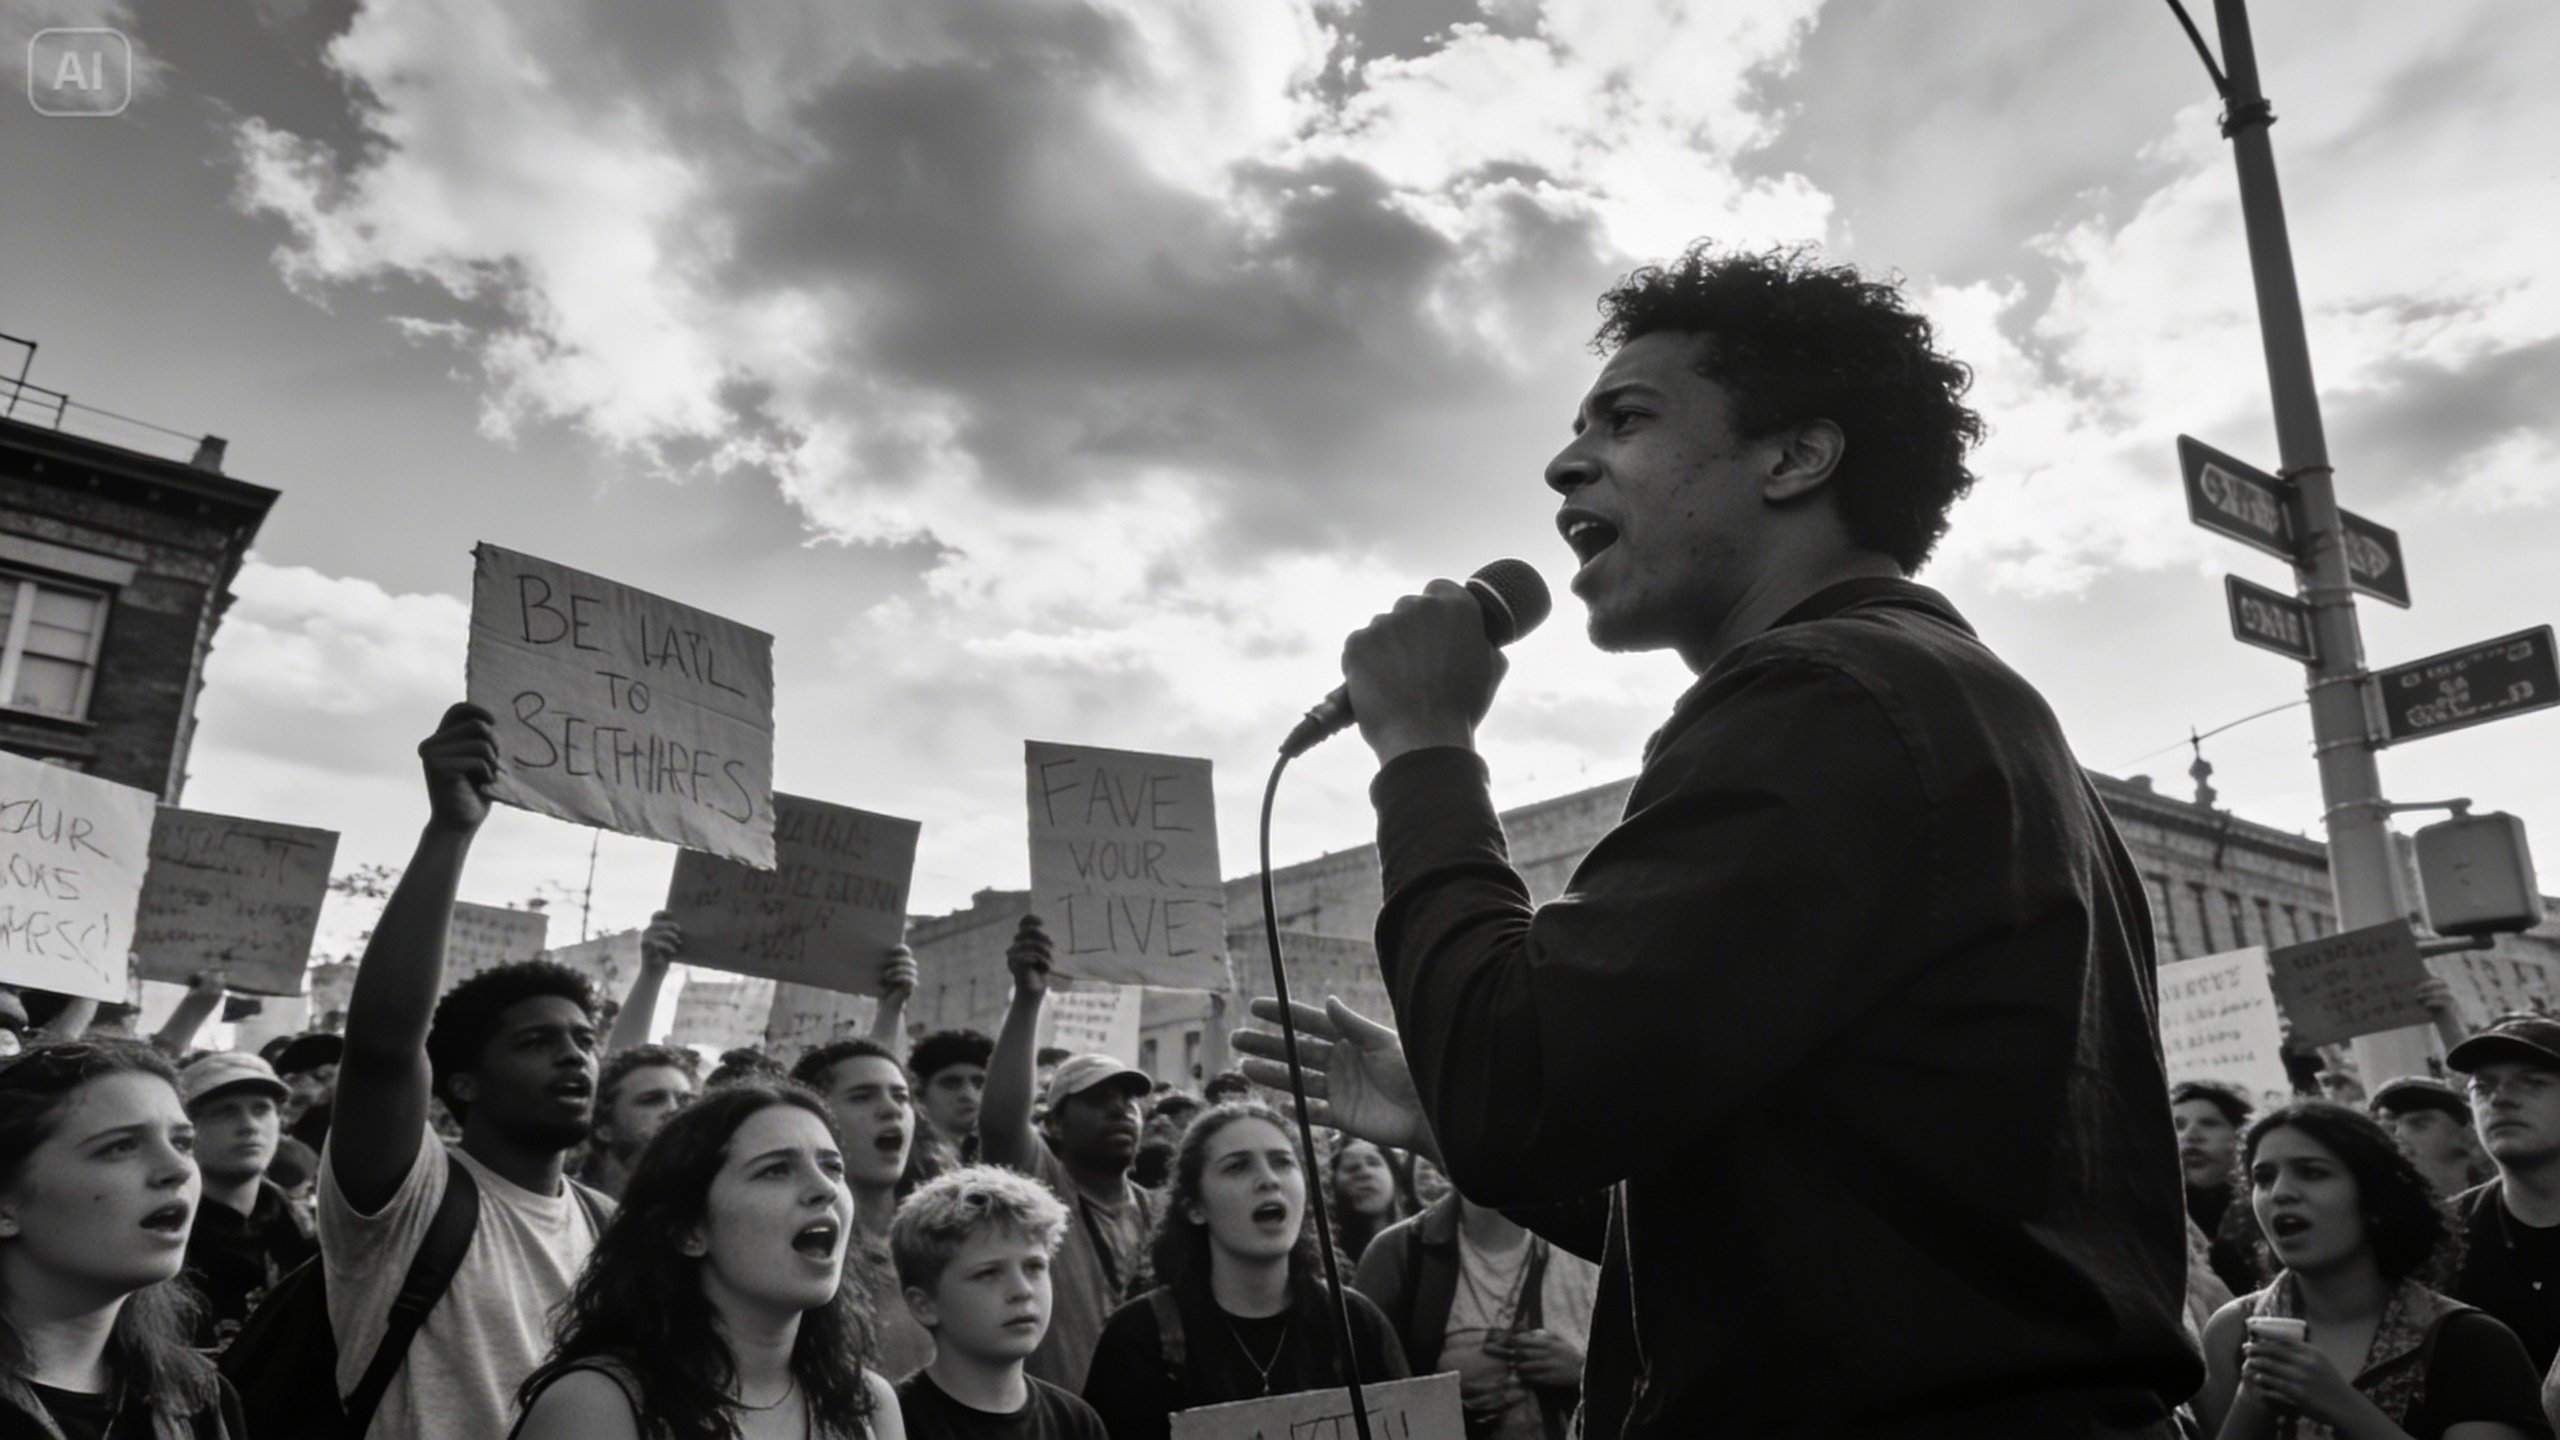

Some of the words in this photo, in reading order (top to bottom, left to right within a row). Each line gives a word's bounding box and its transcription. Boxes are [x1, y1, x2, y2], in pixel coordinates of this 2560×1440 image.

[516, 574, 613, 656] BE
[595, 670, 651, 714] TO
[1040, 758, 1194, 833] FAVE
[1057, 893, 1199, 958] LIVE
